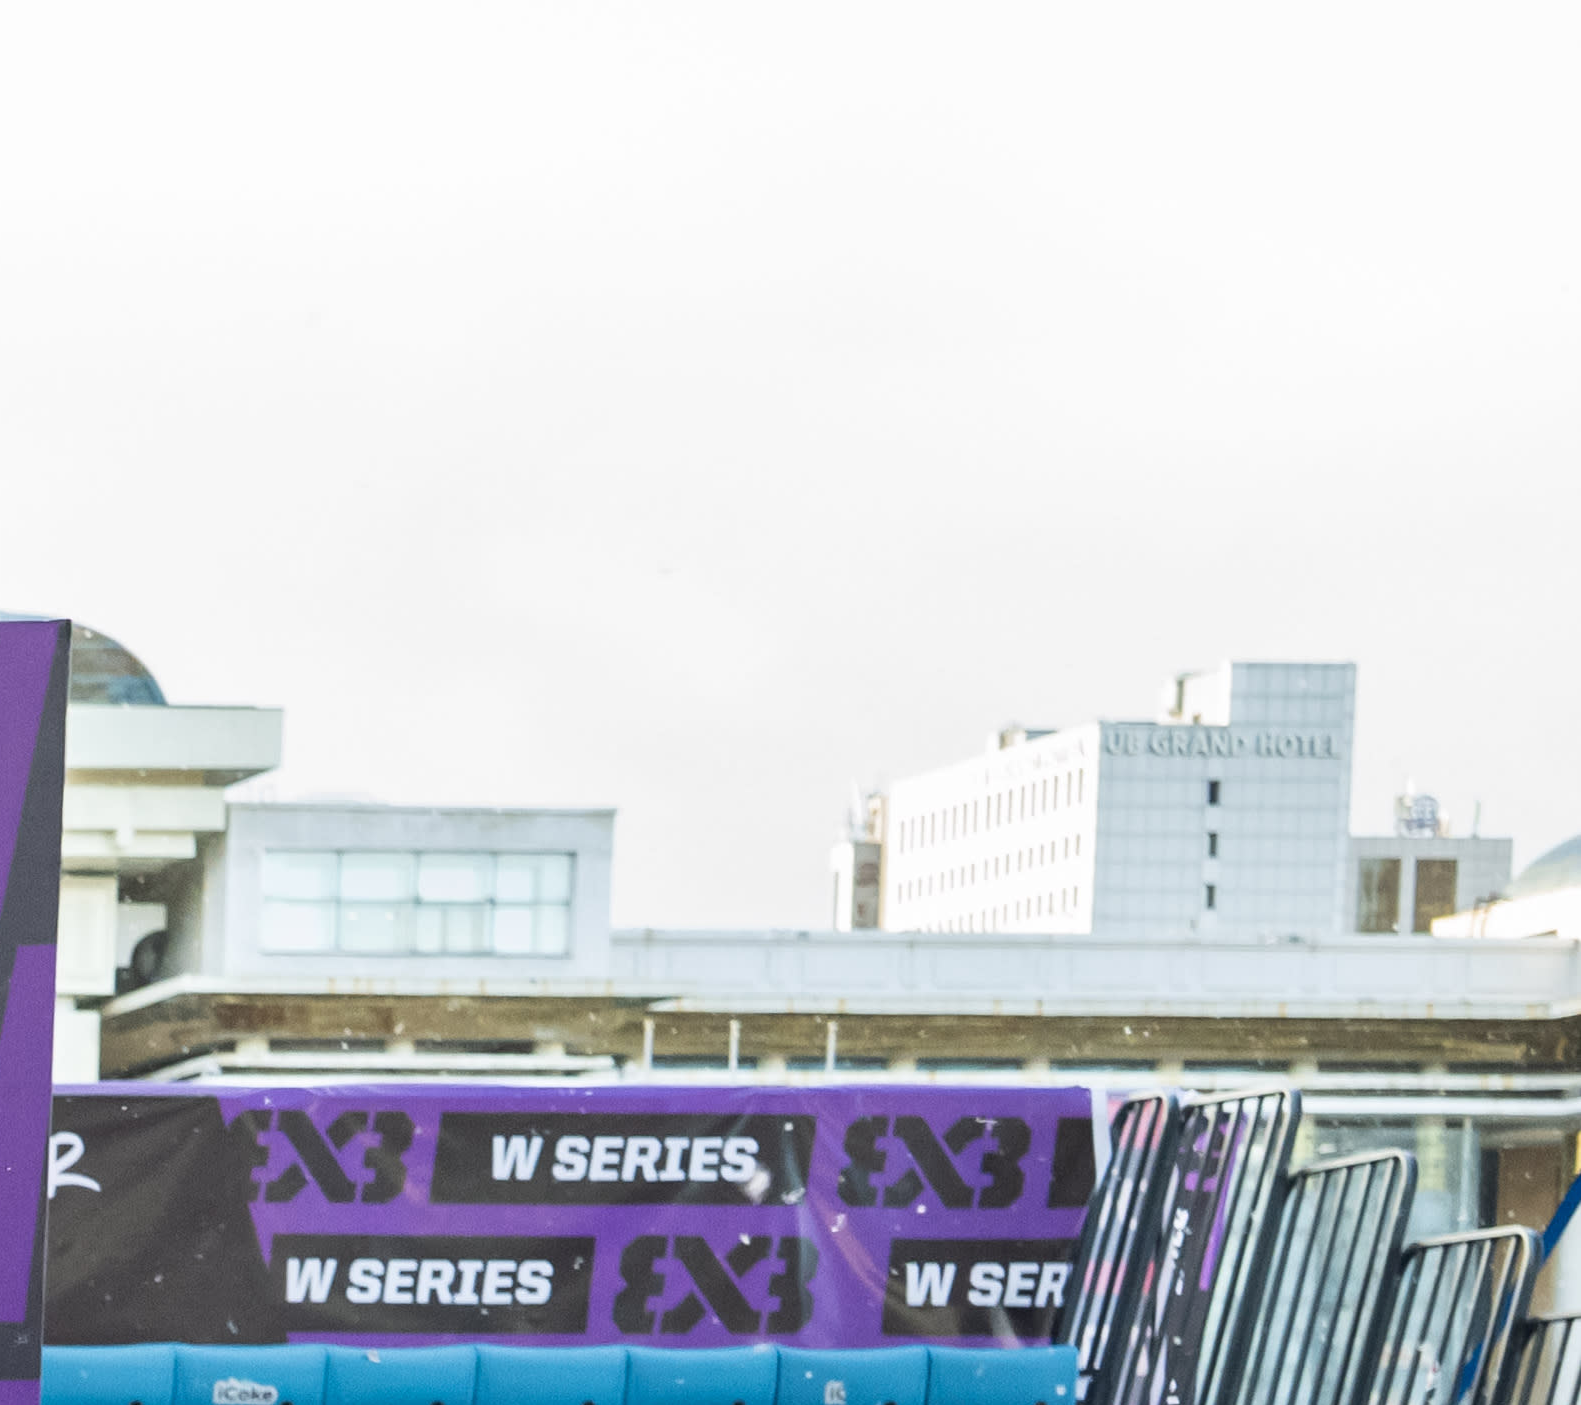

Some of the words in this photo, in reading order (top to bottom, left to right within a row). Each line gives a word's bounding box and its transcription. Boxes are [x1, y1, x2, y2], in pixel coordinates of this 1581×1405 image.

[1106, 731, 1143, 756] UB
[1150, 730, 1247, 758] GRAND
[1256, 730, 1342, 759] HOTEL
[492, 1136, 544, 1181] W
[552, 1136, 760, 1182] SERIES
[285, 1258, 338, 1304] W
[346, 1258, 554, 1305] SERIES
[904, 1262, 957, 1307] W
